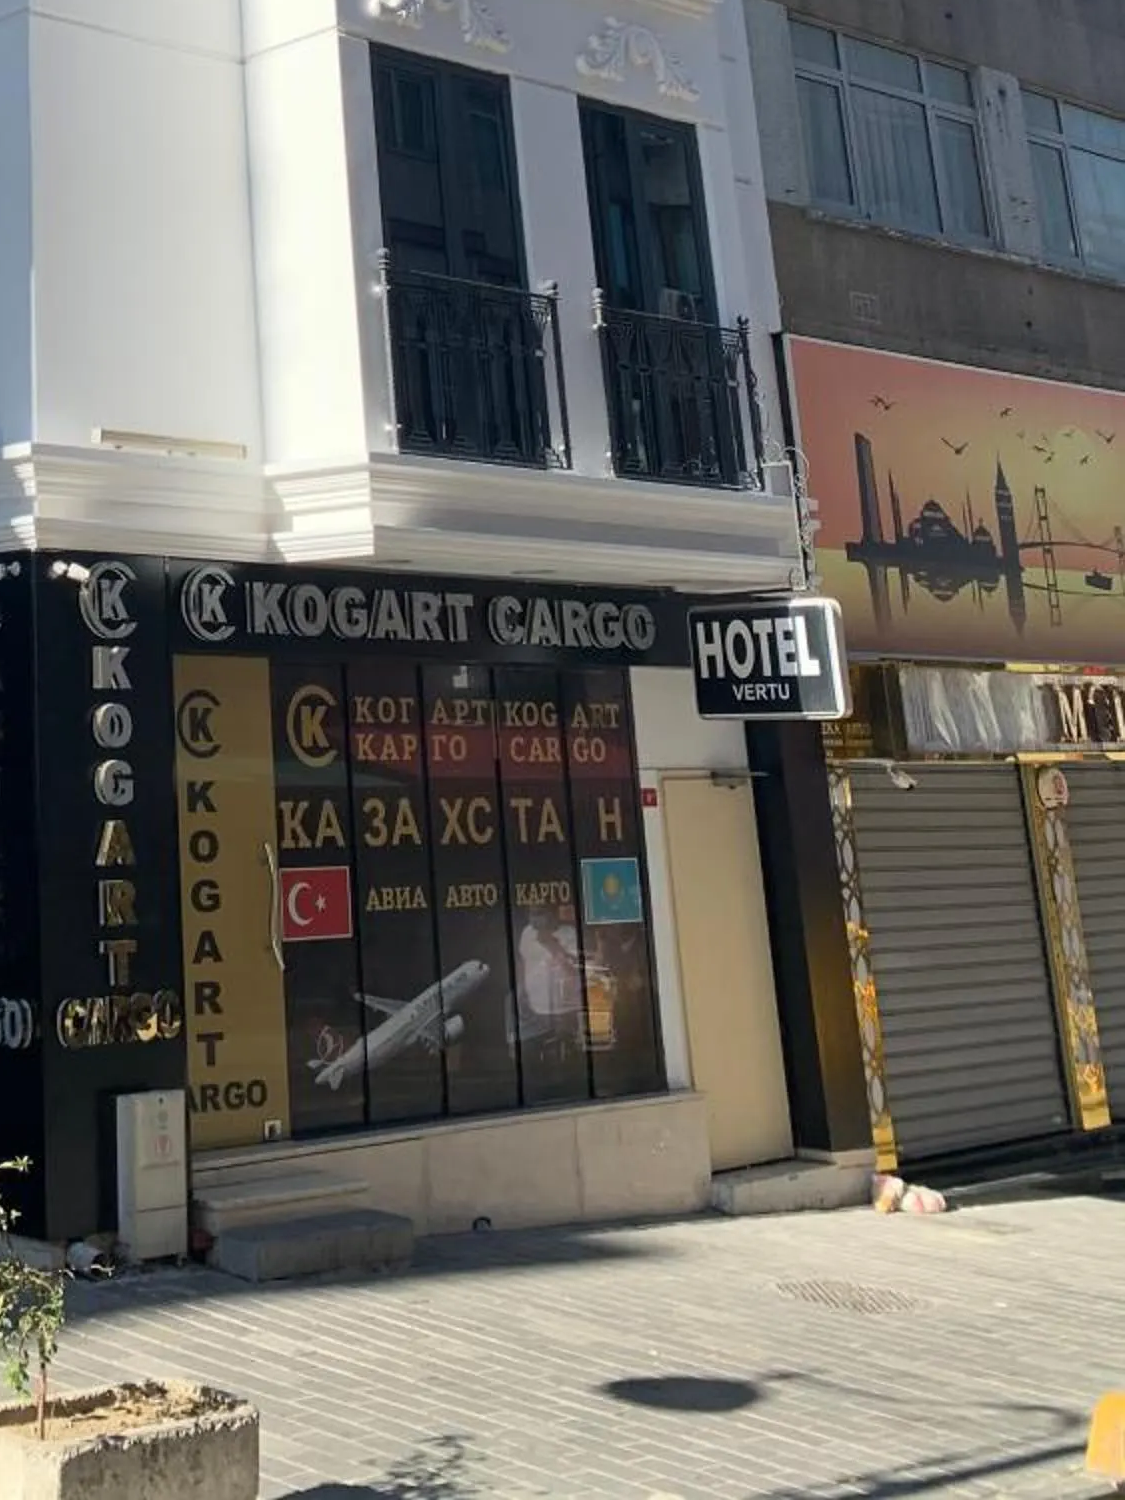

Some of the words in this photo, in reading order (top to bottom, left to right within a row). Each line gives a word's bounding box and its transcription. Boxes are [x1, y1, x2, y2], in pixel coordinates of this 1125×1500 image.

[245, 580, 475, 642] KOGART
[487, 594, 657, 651] CARGO
[695, 615, 822, 680] HOTEL
[732, 683, 791, 702] VERTU
[91, 645, 139, 987] KOGART
[186, 781, 225, 1068] KOGART
